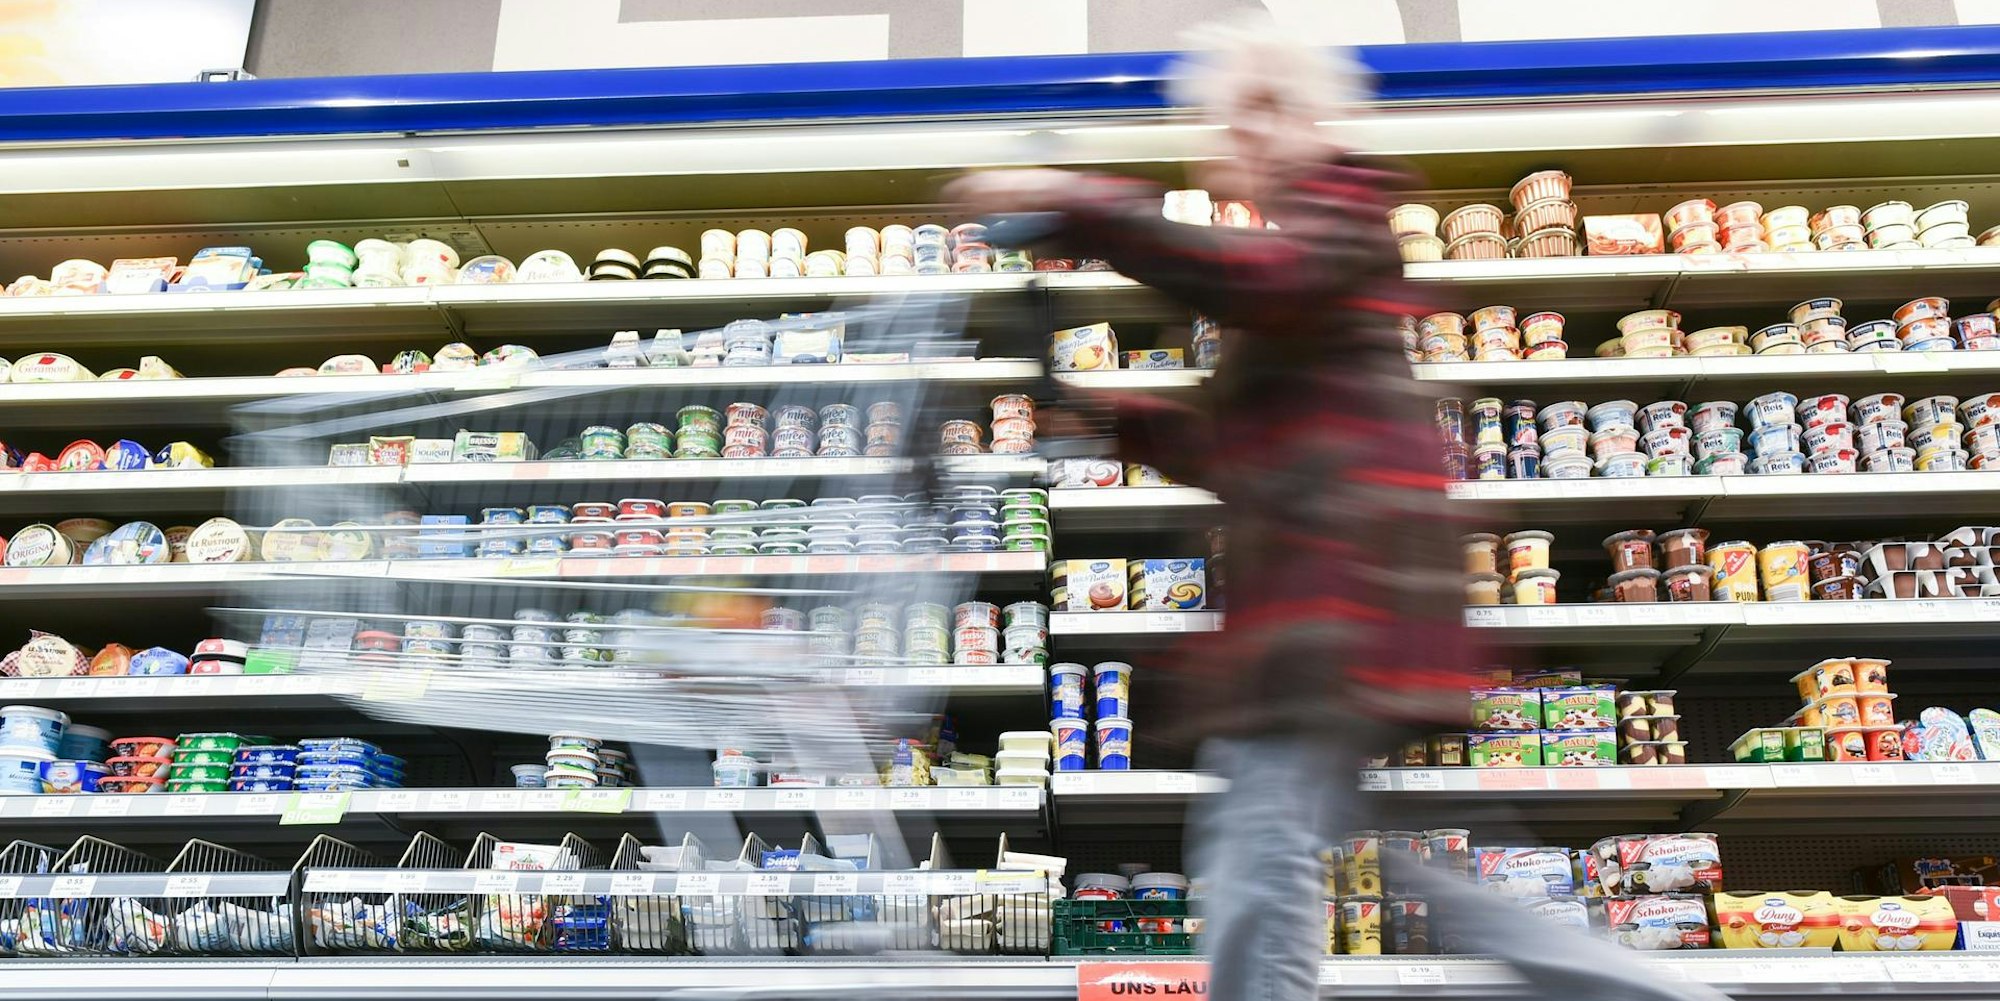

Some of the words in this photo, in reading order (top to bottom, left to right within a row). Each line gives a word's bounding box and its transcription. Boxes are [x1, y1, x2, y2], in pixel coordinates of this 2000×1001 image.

[1763, 403, 1783, 413] Reis
[1862, 405, 1881, 416] Reis
[1966, 407, 1987, 419] Reis
[1652, 412, 1672, 421] Reis
[1801, 410, 1818, 420] Reis
[470, 436, 497, 446] BRESSO
[1651, 439, 1669, 450] Reis
[1703, 440, 1723, 449] Reis
[1809, 436, 1826, 446] Reis
[1915, 436, 1932, 448] Reis
[416, 447, 450, 458] boursin
[1771, 462, 1791, 471] Reis
[1818, 459, 1838, 470] Reis
[191, 540, 199, 548] LE
[201, 537, 241, 547] RUSTIQUE
[960, 631, 986, 641] BRESSO
[1491, 697, 1522, 706] PAULA
[1565, 696, 1597, 705] PAULA
[1490, 739, 1522, 748] PAULA
[1564, 739, 1597, 748] PAULA
[1648, 844, 1687, 857] Schoko
[1676, 853, 1701, 862] Sahne
[509, 859, 545, 870] PATROS
[1505, 857, 1541, 870] Schoko
[1637, 905, 1674, 917] Schoko
[1760, 908, 1796, 923] Dany
[1664, 914, 1689, 925] Sahne
[1877, 912, 1912, 927] Dany
[1111, 981, 1157, 995] UNS
